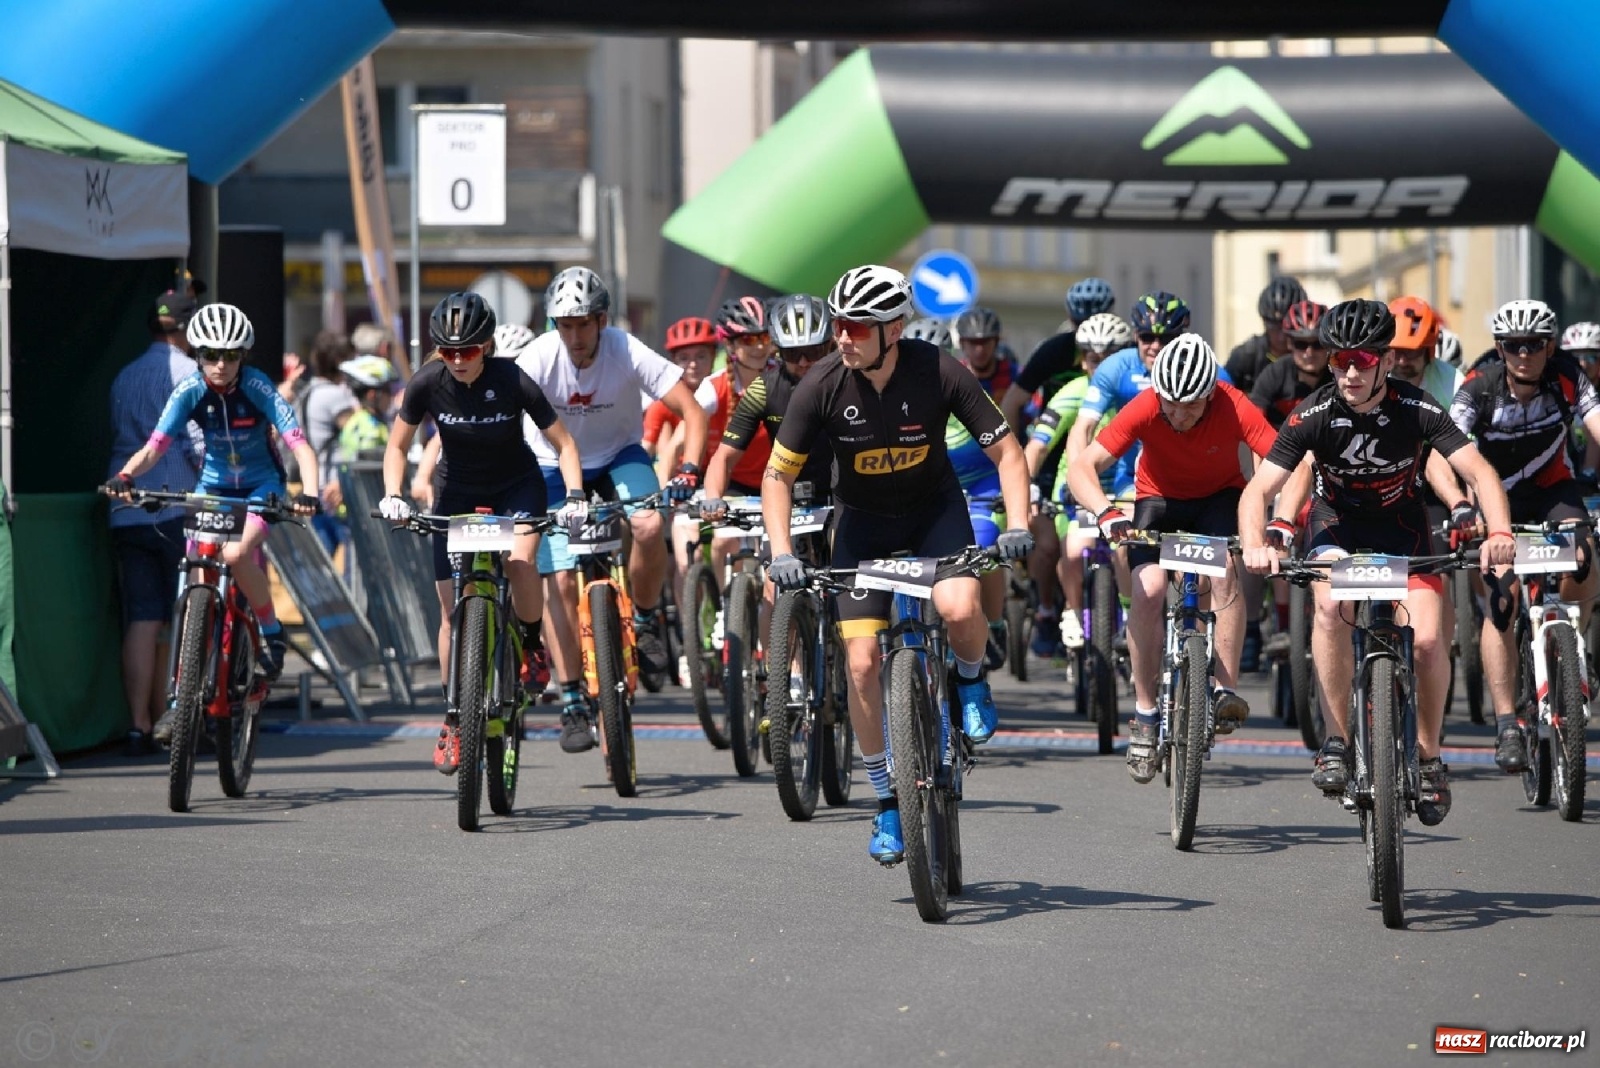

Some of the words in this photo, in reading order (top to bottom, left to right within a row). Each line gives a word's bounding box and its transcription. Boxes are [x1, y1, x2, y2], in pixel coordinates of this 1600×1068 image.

[451, 178, 472, 211] 0
[991, 176, 1470, 220] MERIDA
[1398, 394, 1442, 414] ROSS
[861, 449, 923, 470] RMF
[1174, 543, 1215, 561] 1476
[1527, 546, 1560, 559] 2117
[871, 559, 923, 578] 2205
[1345, 566, 1393, 582] 1298
